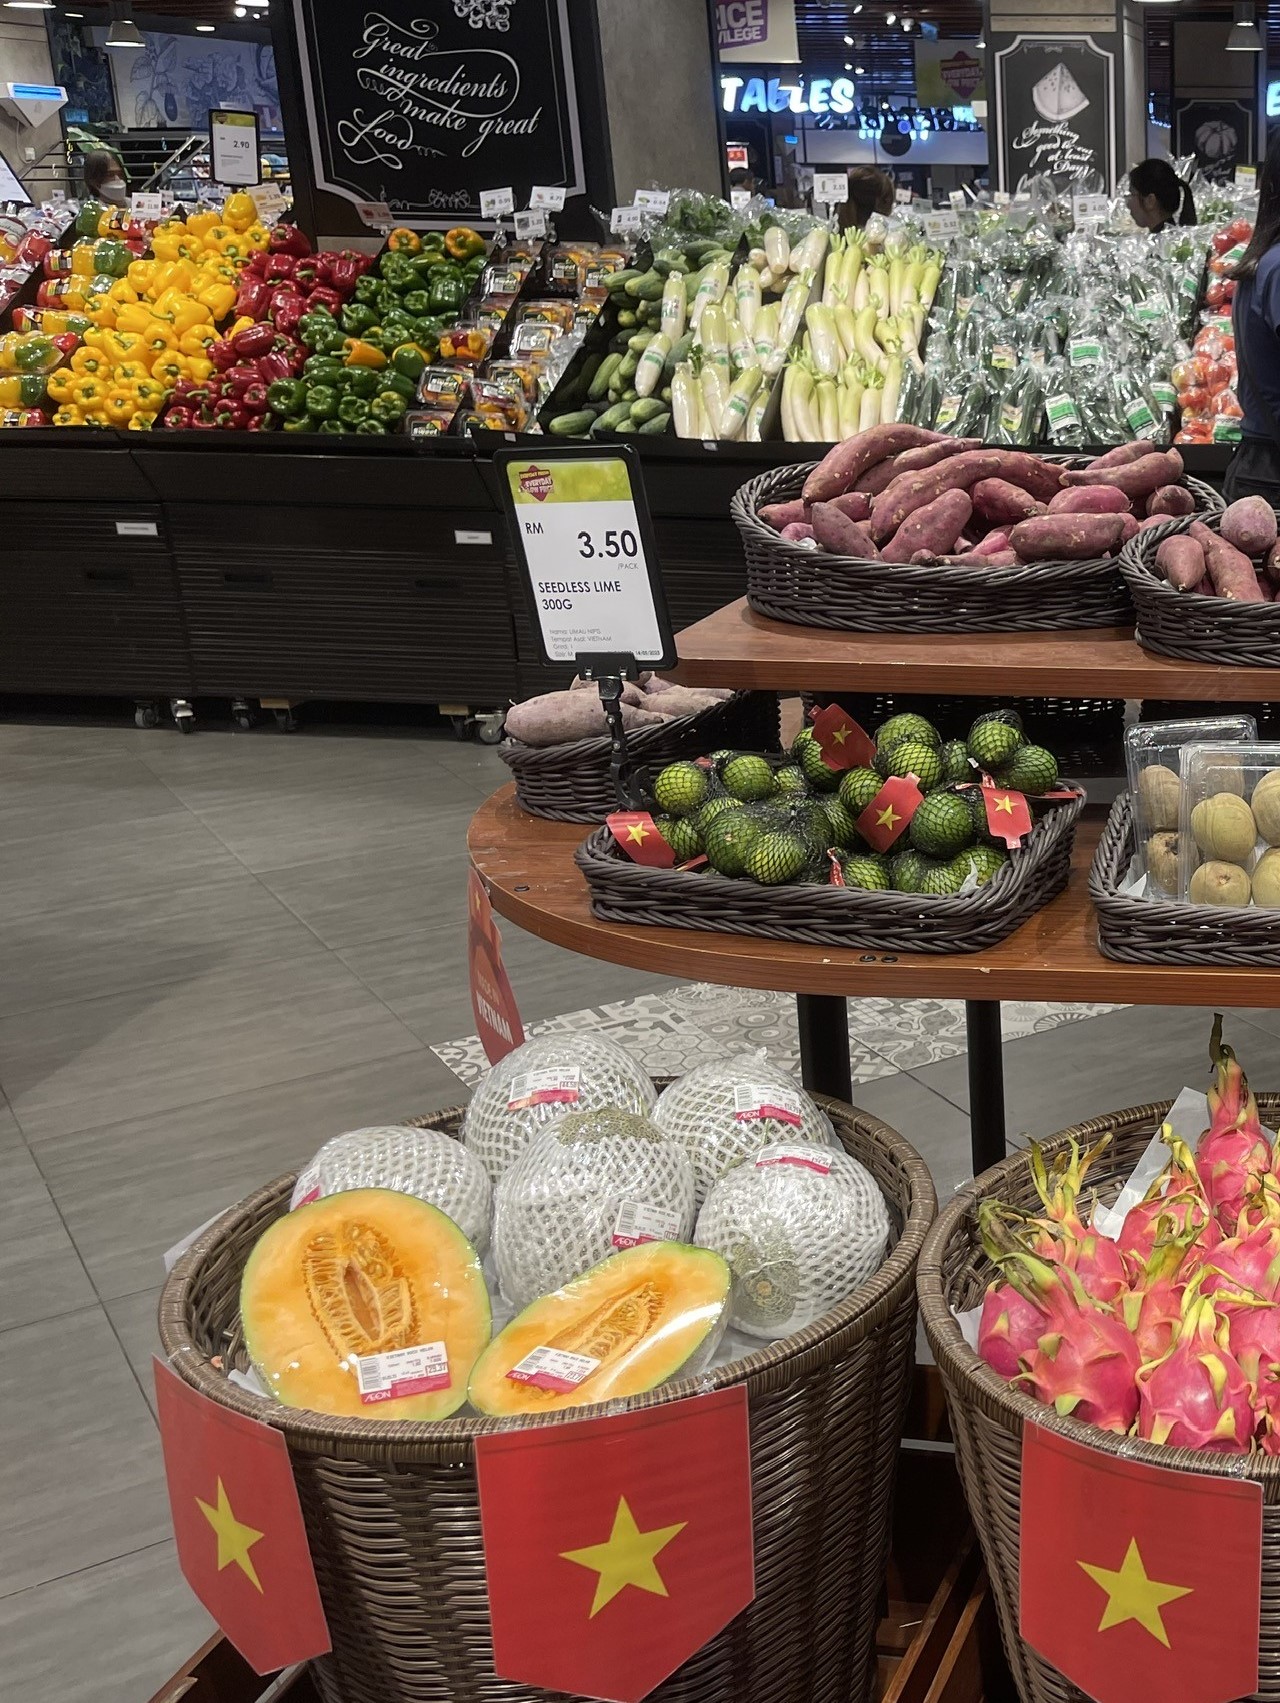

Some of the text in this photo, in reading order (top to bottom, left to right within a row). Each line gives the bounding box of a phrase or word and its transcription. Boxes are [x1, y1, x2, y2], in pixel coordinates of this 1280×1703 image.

[716, 2, 764, 30] ICE
[353, 20, 432, 60] Great
[380, 58, 509, 98] ingredients
[400, 99, 542, 157] make great
[233, 140, 250, 149] 2.90
[525, 476, 552, 487] EVERYDAY
[525, 522, 638, 559] RM 3.50
[538, 580, 622, 593] SEEDLESS LIME
[542, 599, 573, 610] 300G
[476, 990, 514, 1045] VIETNAM
[364, 1390, 392, 1403] AEON
